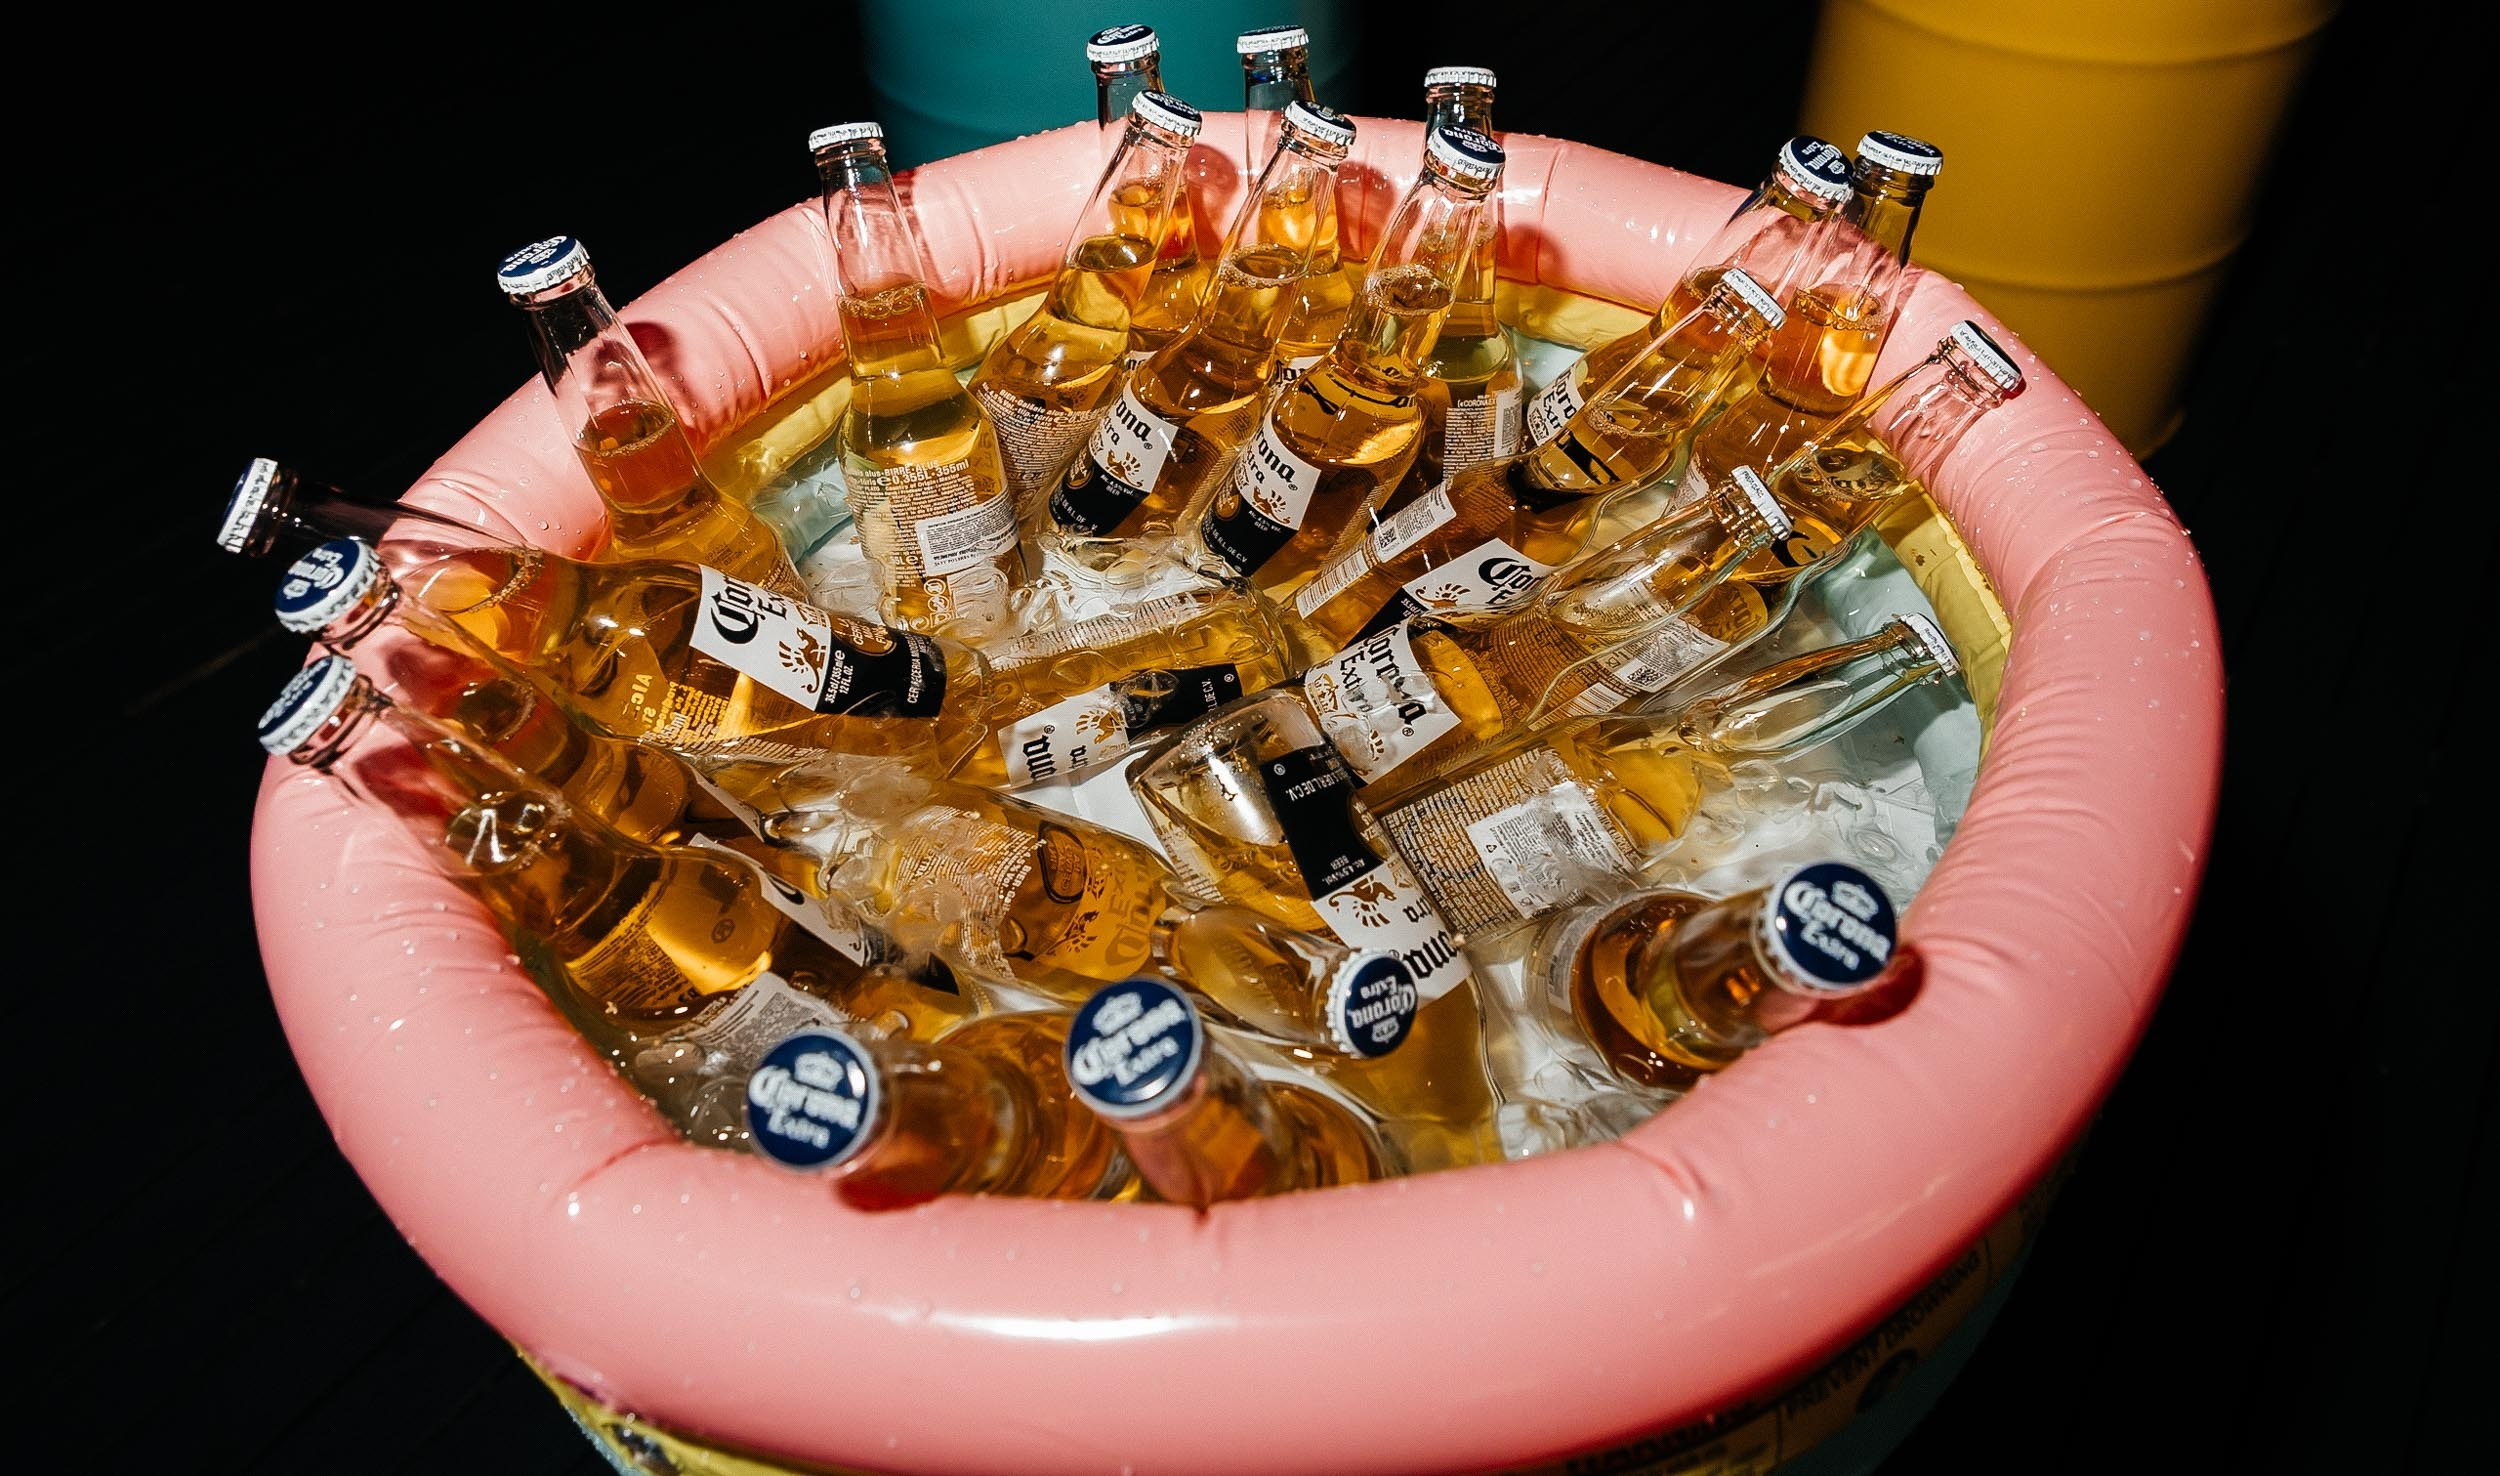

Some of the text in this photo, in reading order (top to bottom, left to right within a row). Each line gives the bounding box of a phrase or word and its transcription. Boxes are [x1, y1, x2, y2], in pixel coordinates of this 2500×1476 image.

[1783, 880, 1892, 963] Corona
[1346, 982, 1416, 1030] Corona
[1359, 975, 1398, 1000] Extra
[1071, 998, 1187, 1086] Corona
[748, 1065, 861, 1131] Corona
